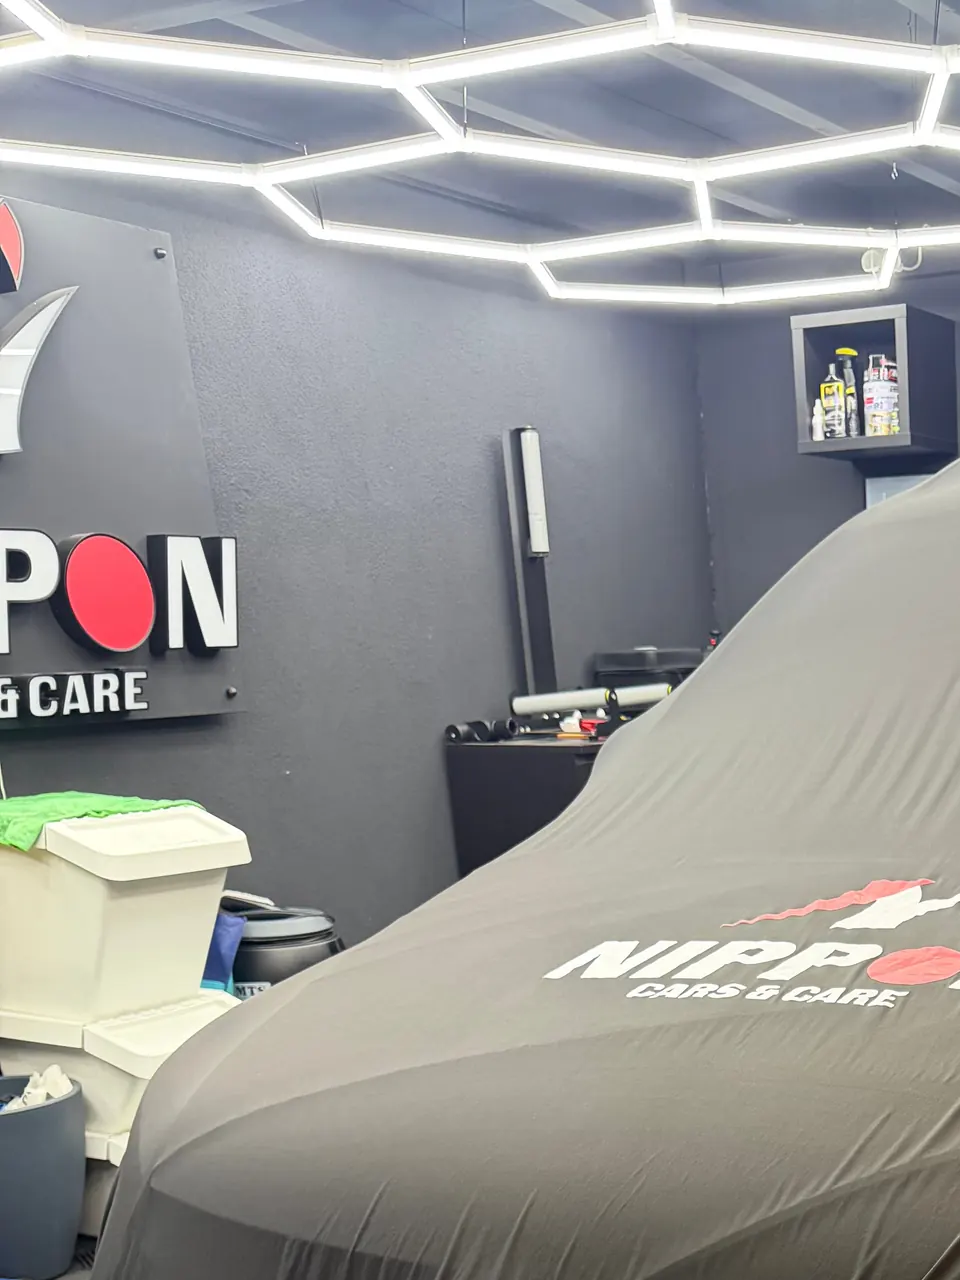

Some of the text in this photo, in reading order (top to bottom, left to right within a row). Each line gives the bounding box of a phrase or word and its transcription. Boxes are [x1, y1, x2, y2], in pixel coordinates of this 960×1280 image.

[28, 671, 148, 718] CARE
[625, 981, 910, 1009] CARS & CARE
